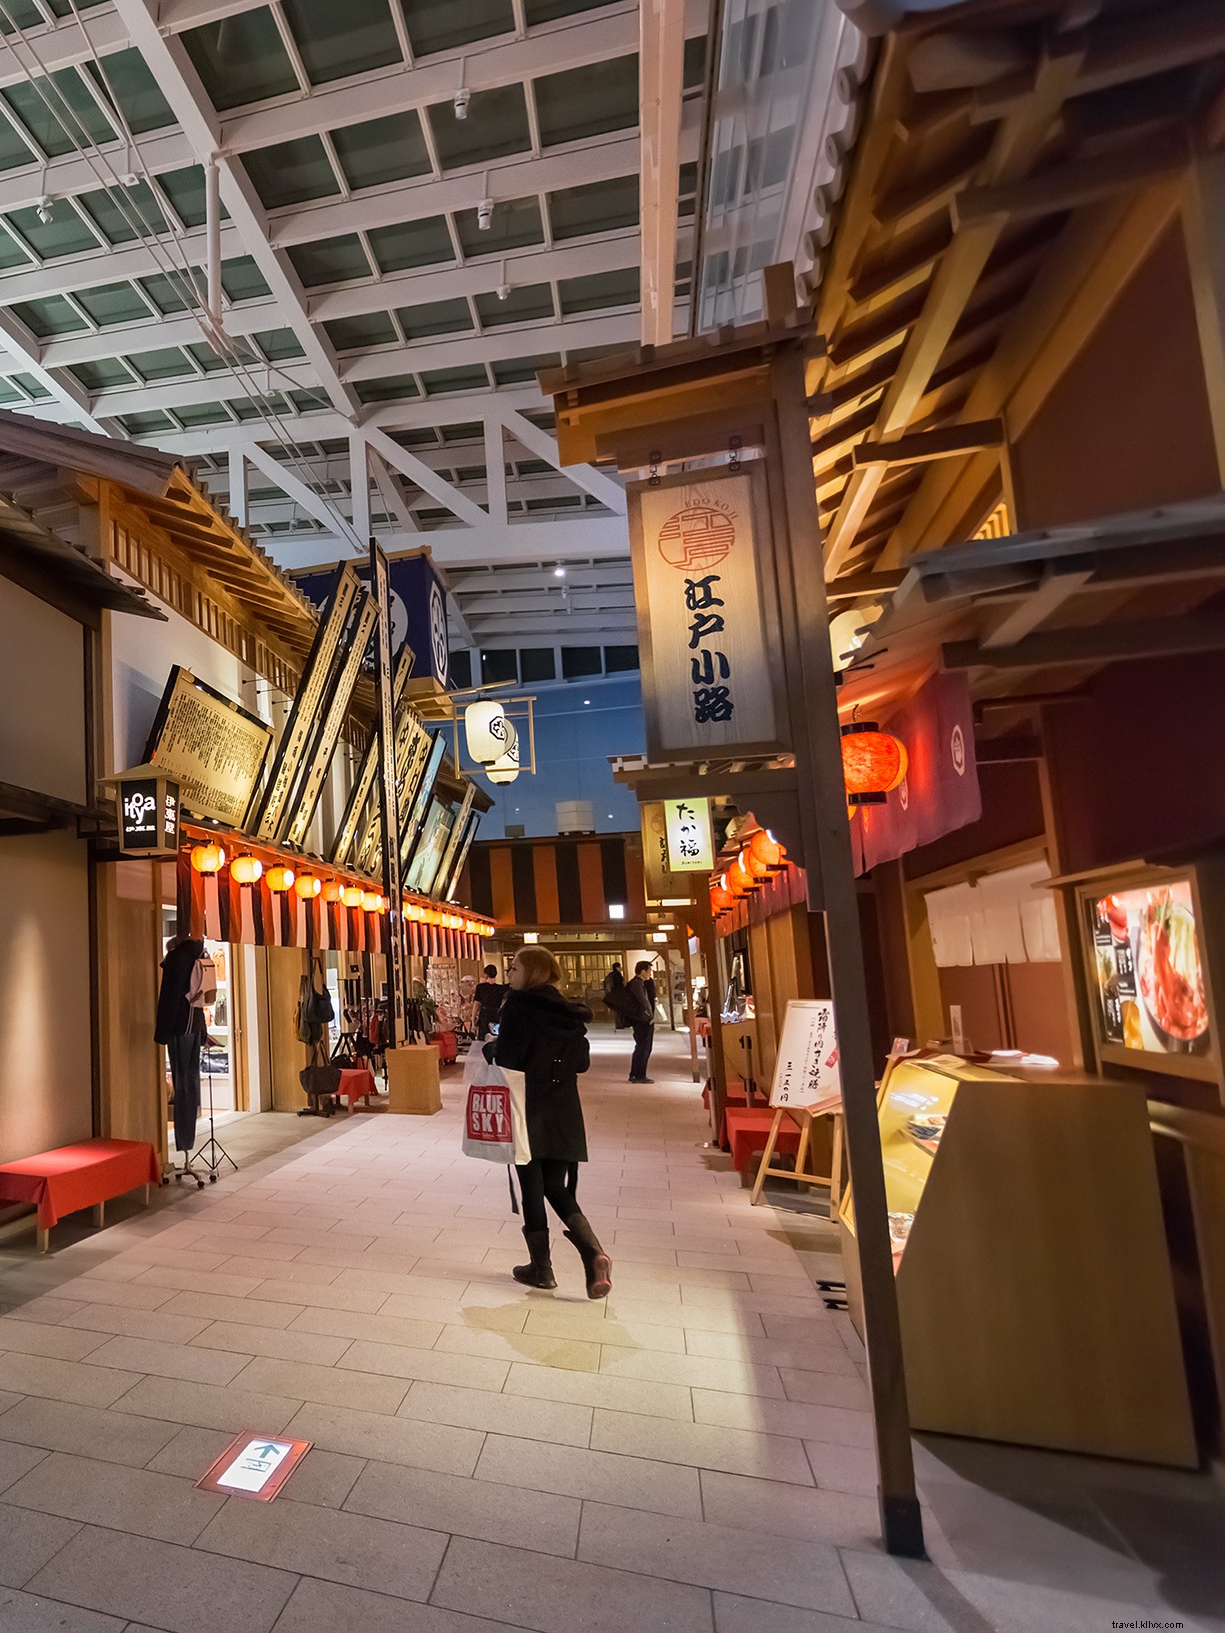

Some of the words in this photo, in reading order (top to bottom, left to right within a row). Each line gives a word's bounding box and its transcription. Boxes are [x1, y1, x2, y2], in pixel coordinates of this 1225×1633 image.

[685, 498, 710, 508] EDO
[714, 500, 739, 520] KOJI
[684, 575, 734, 724] 江戸小路
[164, 795, 176, 834] 伊東屋
[676, 803, 700, 857] たか福
[472, 1093, 504, 1114] BLUE
[472, 1112, 504, 1133] SKY
